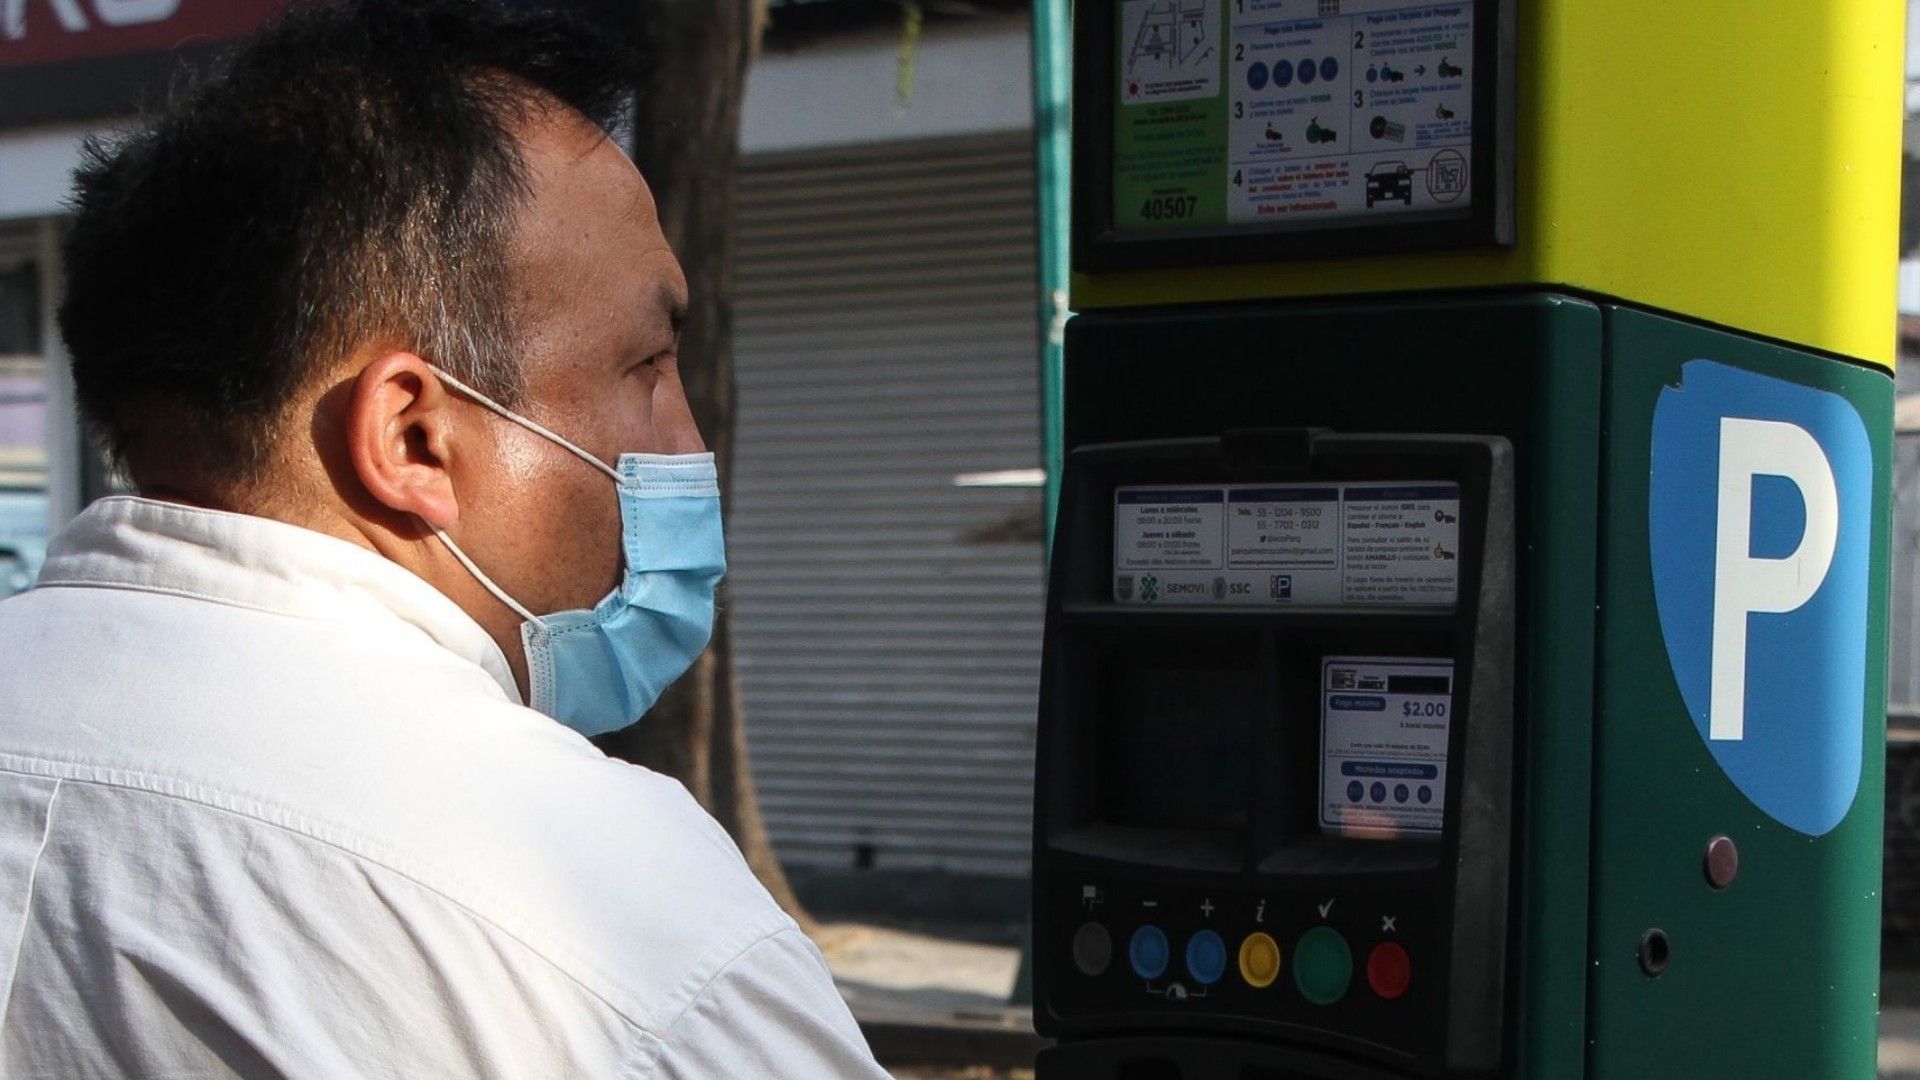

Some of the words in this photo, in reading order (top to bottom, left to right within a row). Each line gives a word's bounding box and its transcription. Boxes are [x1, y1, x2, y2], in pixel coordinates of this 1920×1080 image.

[1354, 31, 1364, 50] 2
[1235, 43, 1246, 62] 2
[1354, 90, 1363, 108] 3
[1235, 101, 1245, 119] 3
[1233, 169, 1243, 187] 4
[1140, 195, 1198, 221] 40507
[1709, 416, 1839, 741] P
[1167, 583, 1206, 594] SEMOVI
[1230, 583, 1251, 594] SSC
[1403, 701, 1446, 718] $2.00
